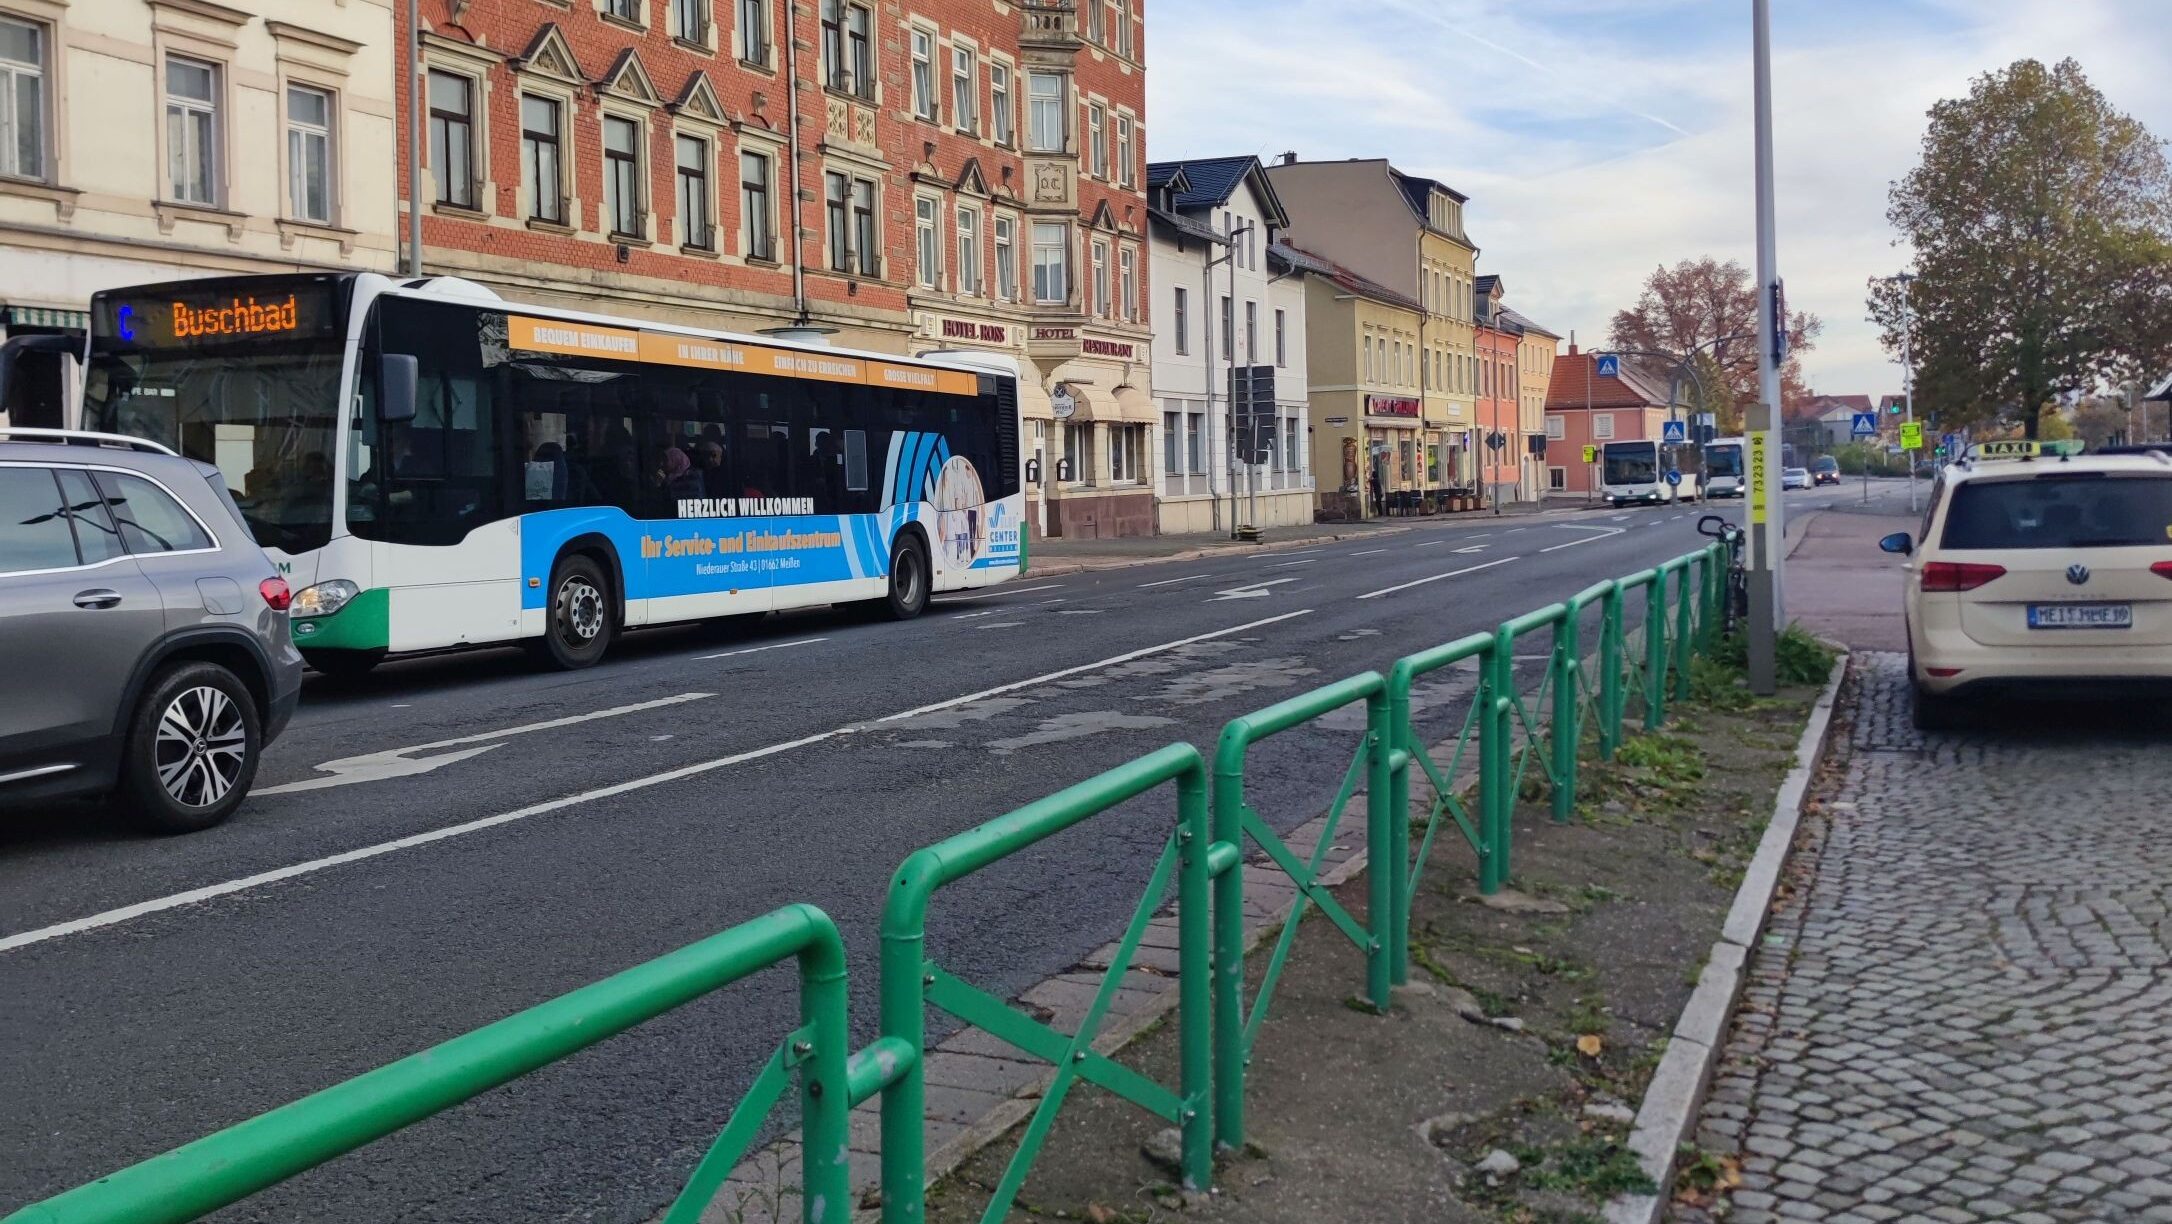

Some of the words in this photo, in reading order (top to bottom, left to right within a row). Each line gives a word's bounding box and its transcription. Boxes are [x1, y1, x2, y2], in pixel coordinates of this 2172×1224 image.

[118, 304, 134, 341] C
[172, 294, 297, 337] Buschbad
[533, 326, 579, 347] BEQUEM
[580, 332, 637, 353] EINKAUFEN
[942, 319, 979, 339] HOTEL
[979, 324, 1005, 342] ROSS
[1035, 328, 1077, 340] HOTEL
[1082, 338, 1134, 358] RESTAURANT
[1984, 443, 2033, 454] TAXI
[677, 498, 736, 518] HERZLICH
[738, 497, 814, 516] WILLKOMMEN
[641, 534, 663, 558] Ihr
[664, 532, 716, 557] Service-
[719, 531, 743, 554] und
[746, 529, 841, 552] Einkaufszentrum
[989, 530, 1018, 543] CENTER
[696, 561, 730, 576] Niederauer
[730, 560, 749, 573] Straße
[749, 559, 757, 571] 43
[761, 558, 779, 571] 01662
[780, 557, 800, 569] Meißen
